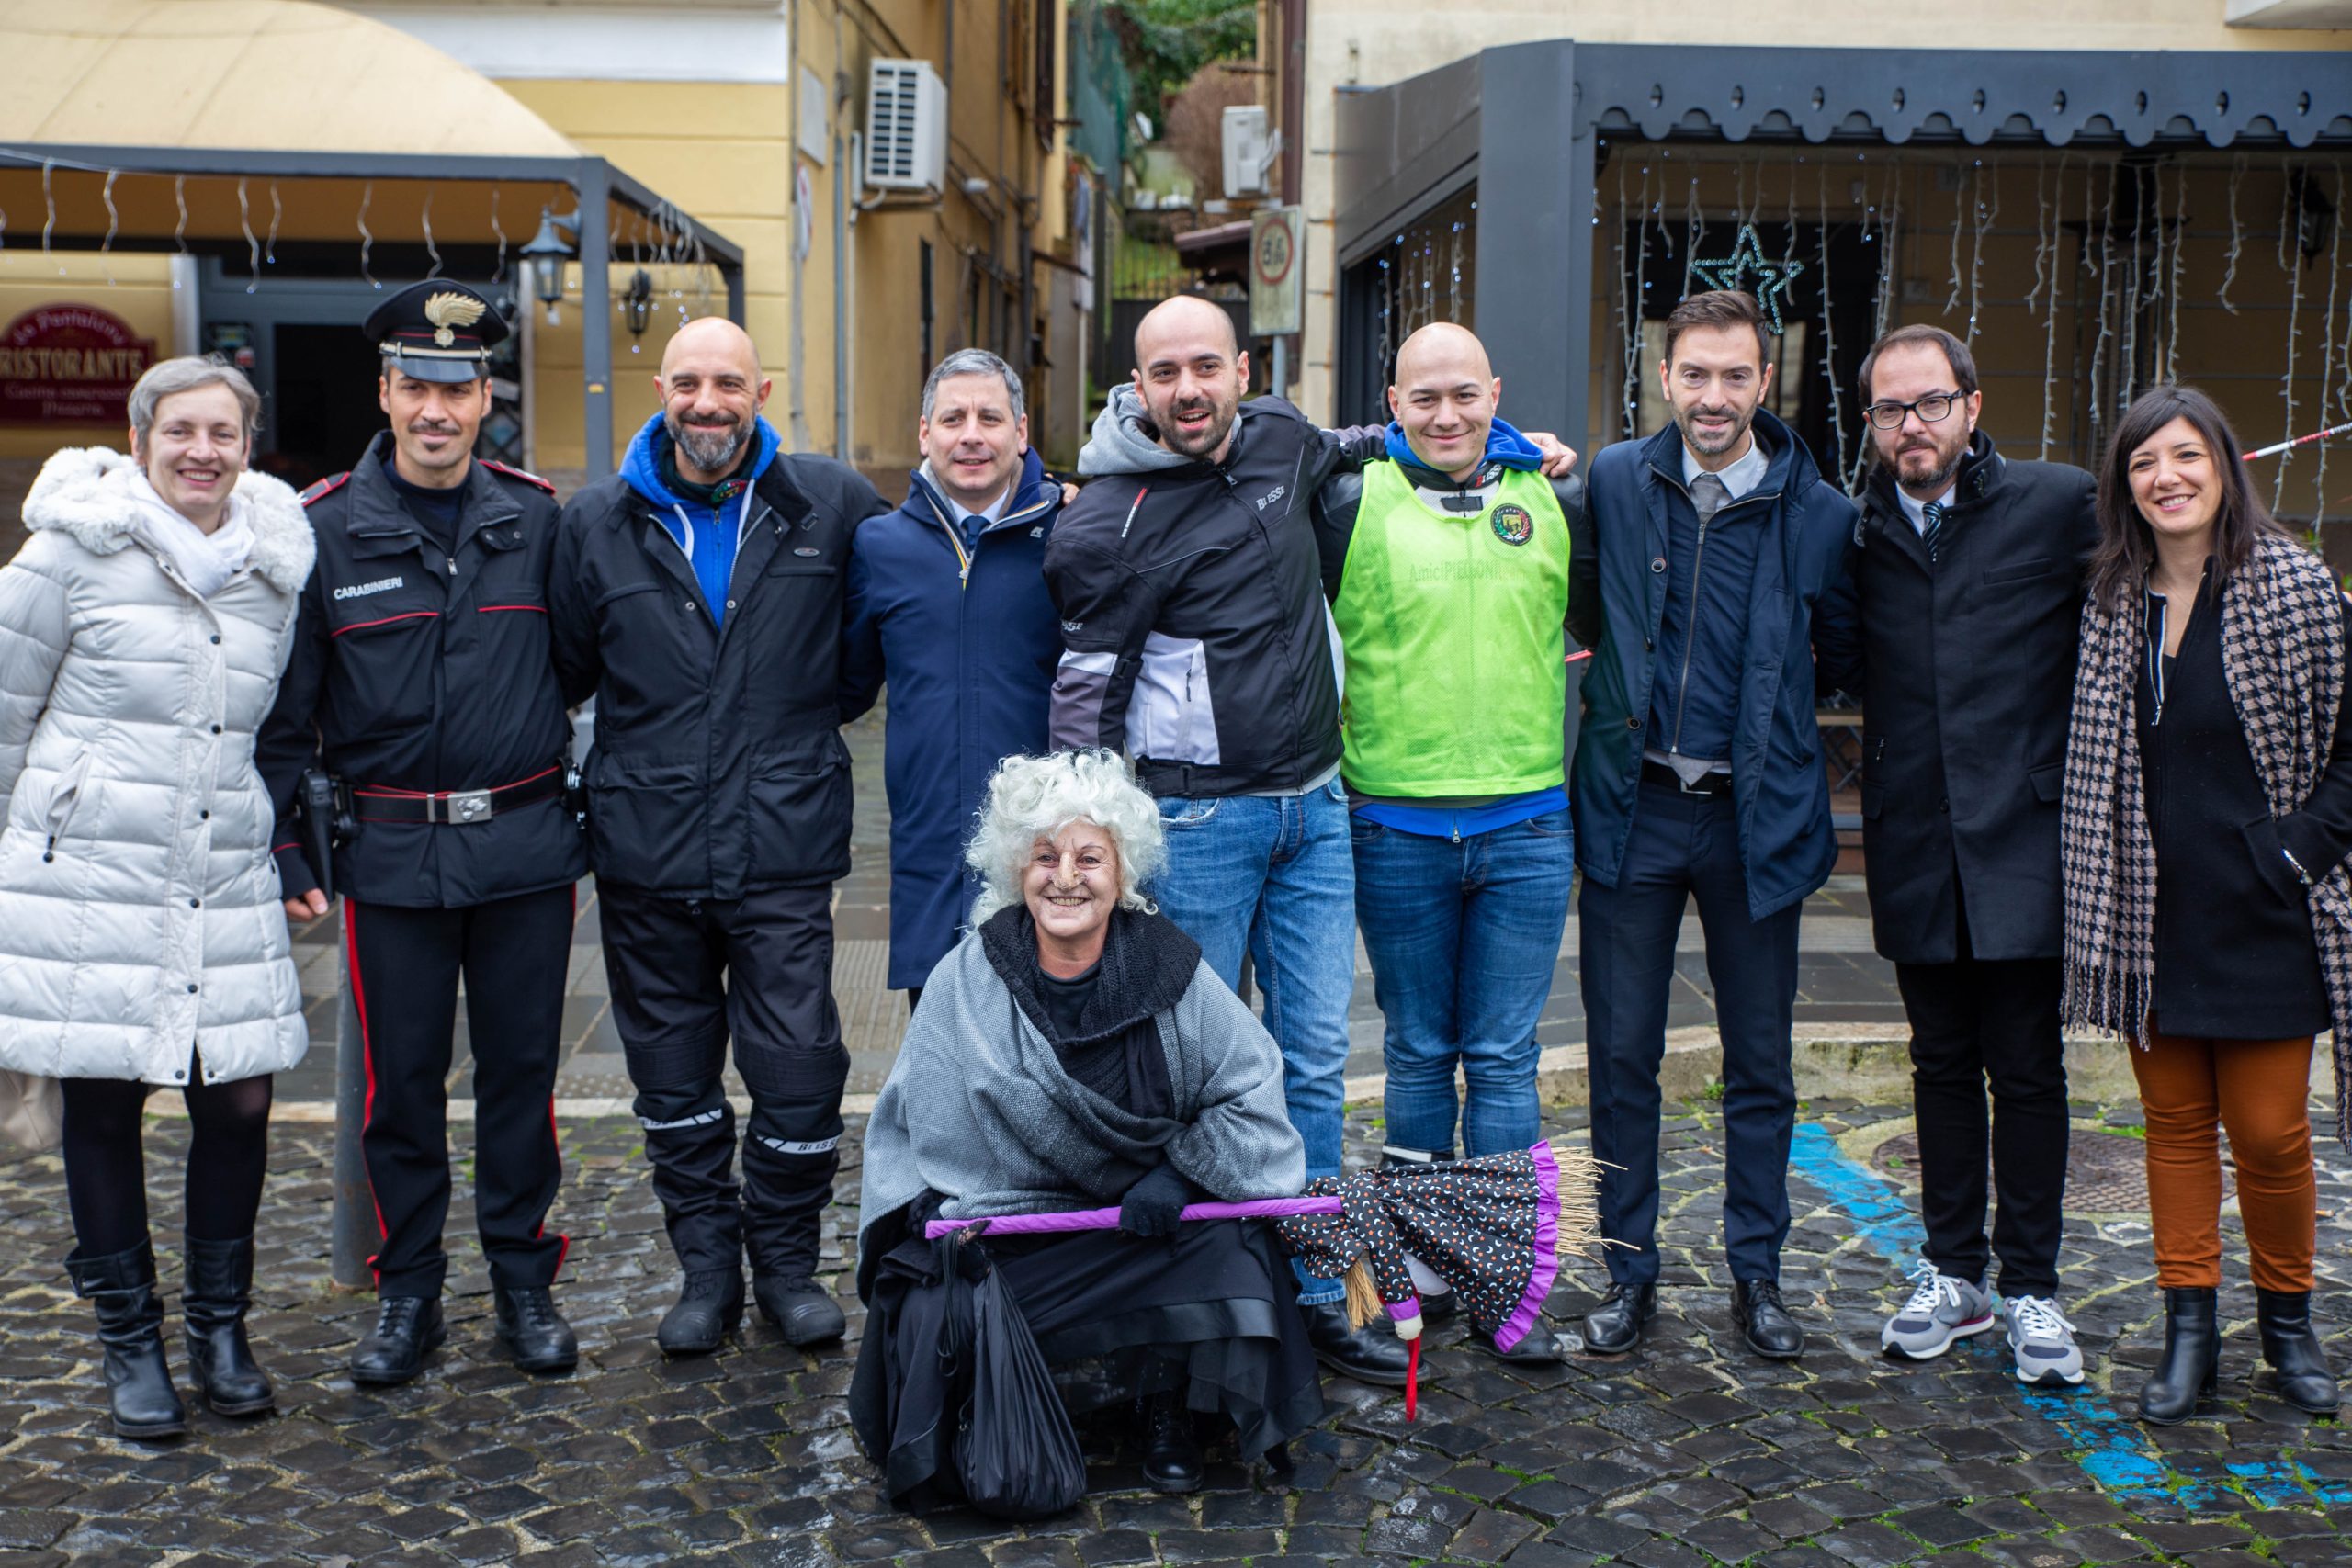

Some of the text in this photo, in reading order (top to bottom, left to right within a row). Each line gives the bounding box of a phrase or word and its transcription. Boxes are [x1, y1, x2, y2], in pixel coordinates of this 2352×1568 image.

[0, 347, 144, 380] RISTORANTE
[1267, 485, 1285, 503] ESSE
[334, 576, 403, 600] CARABINIERI
